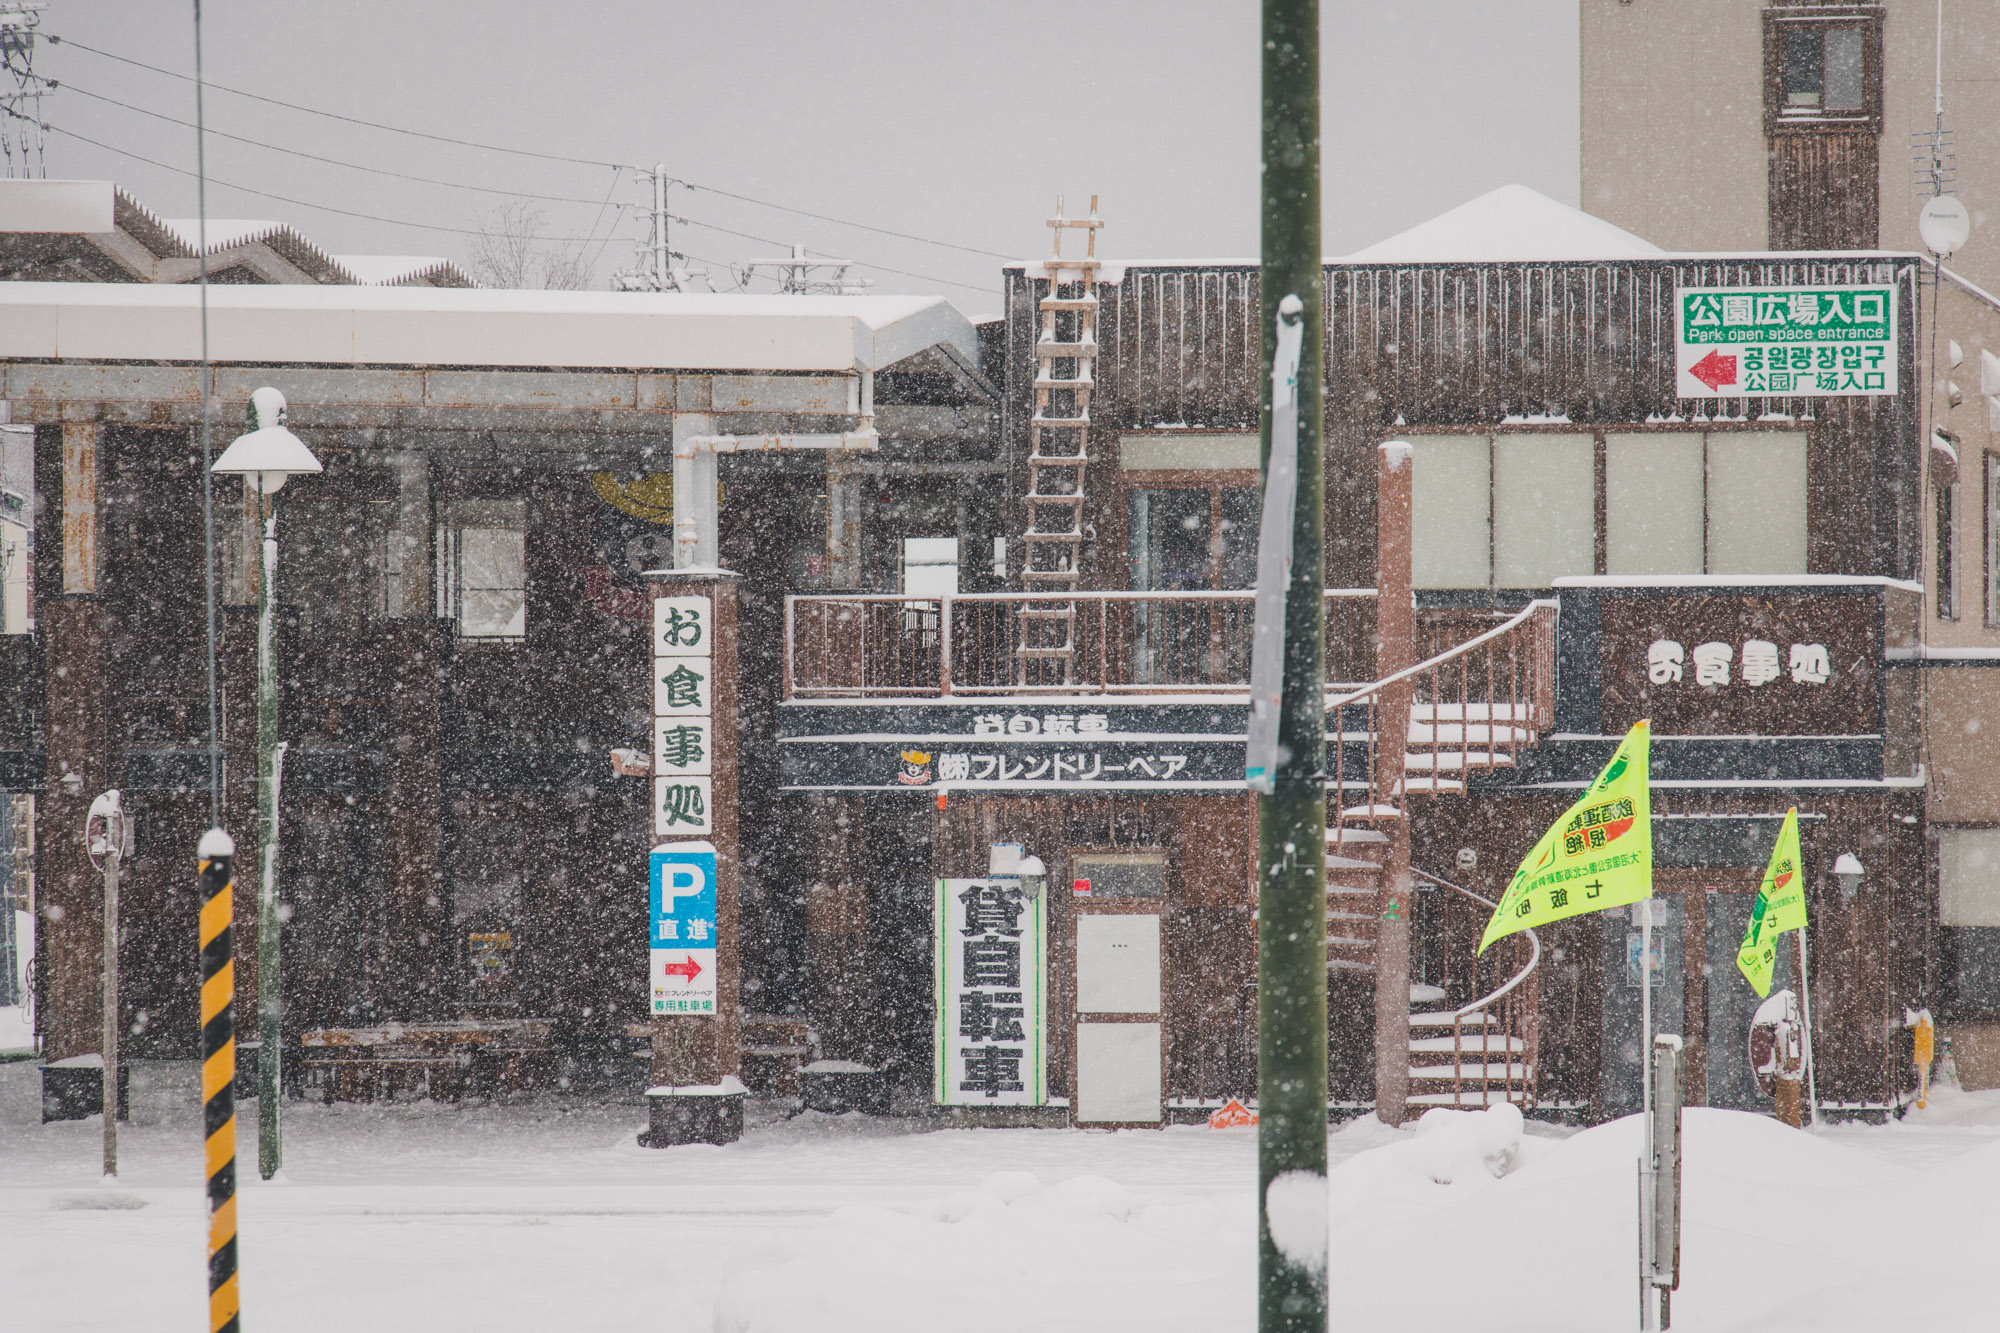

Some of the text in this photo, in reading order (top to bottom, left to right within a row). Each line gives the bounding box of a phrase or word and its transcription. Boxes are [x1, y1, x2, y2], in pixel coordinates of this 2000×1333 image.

[1688, 294, 1884, 327] 公園広場入口
[1688, 327, 1884, 343] Park open space entrance
[1743, 345, 1886, 371] 공원광장입구
[1743, 372, 1886, 392] 公园广场入口
[661, 606, 705, 827] お食事処
[661, 863, 706, 914] P
[658, 918, 709, 940] 直進
[958, 884, 1026, 1098] 貸自転車
[654, 999, 713, 1012] 専用駐車場
